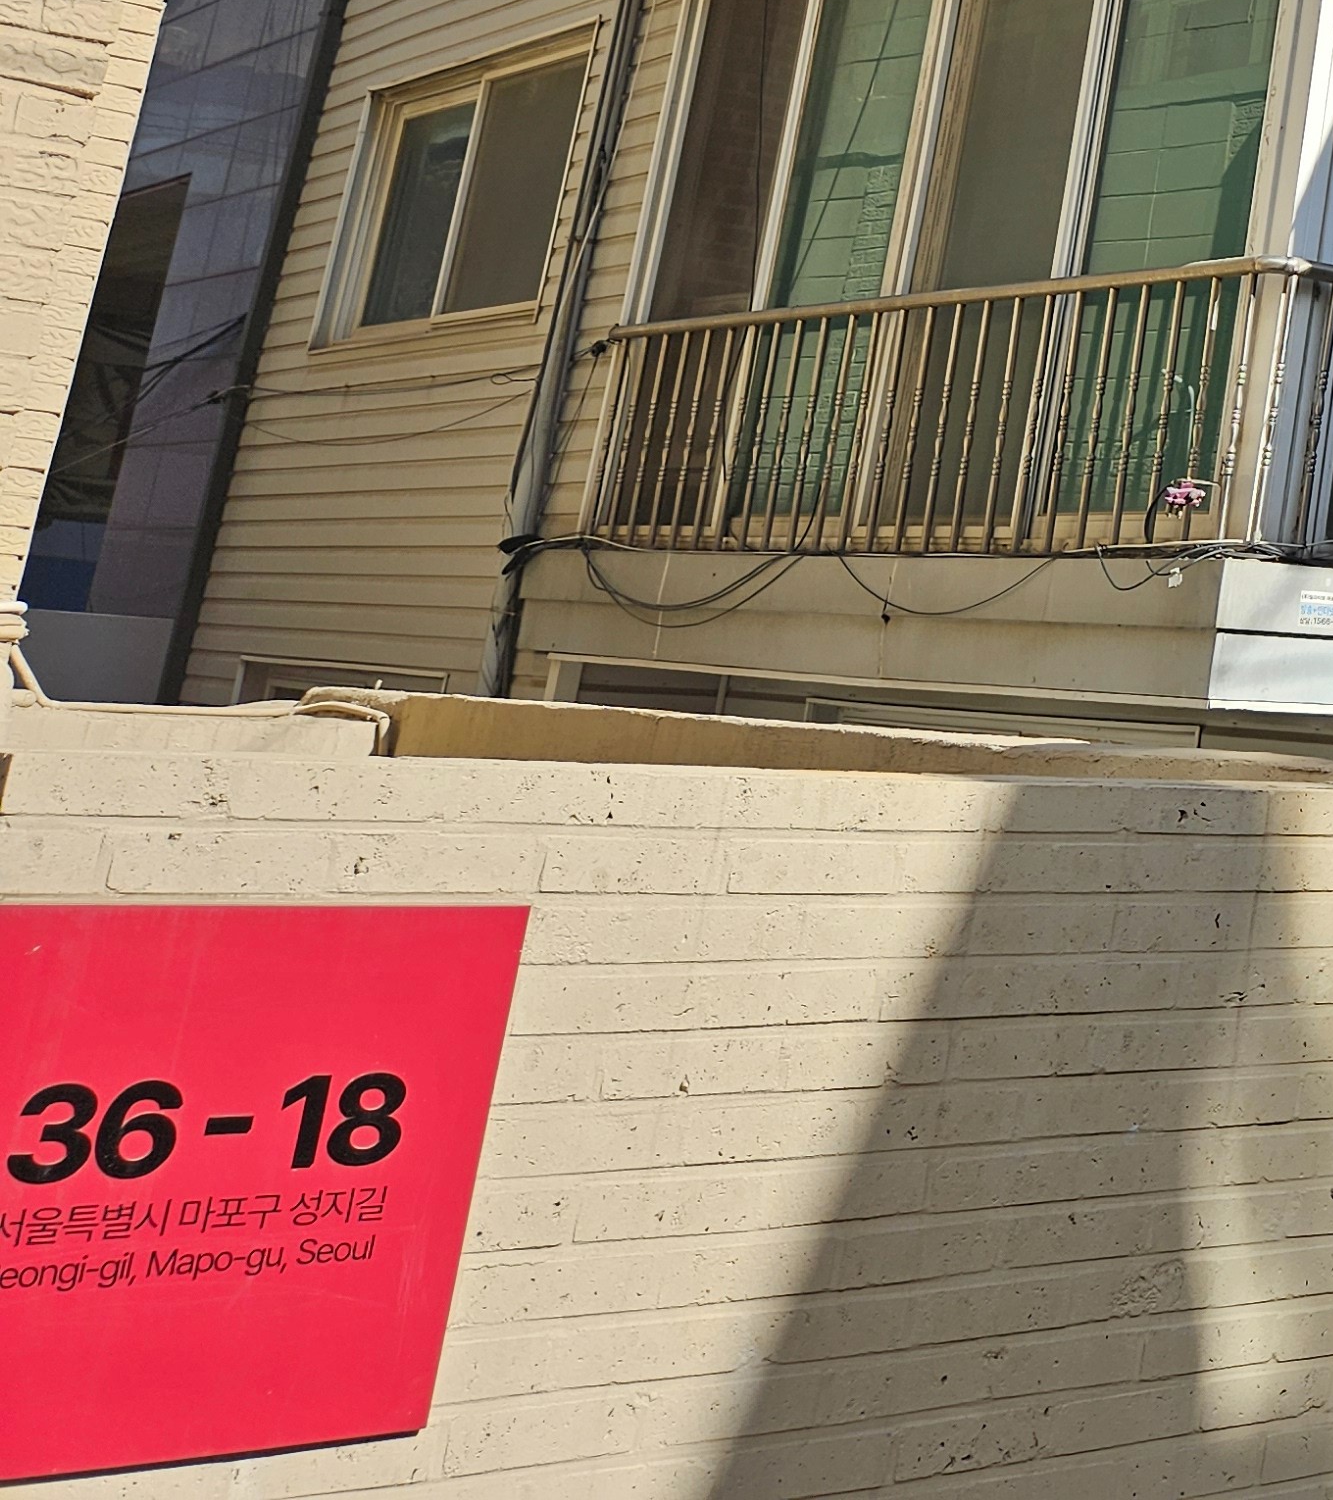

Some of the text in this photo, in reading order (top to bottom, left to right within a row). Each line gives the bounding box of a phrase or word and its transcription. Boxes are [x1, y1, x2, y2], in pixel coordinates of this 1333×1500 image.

[0, 1185, 389, 1248] 서울특별시 마포구 성지길
[0, 1233, 377, 1293] eongi-gil, Mapo-gu, Seoul
